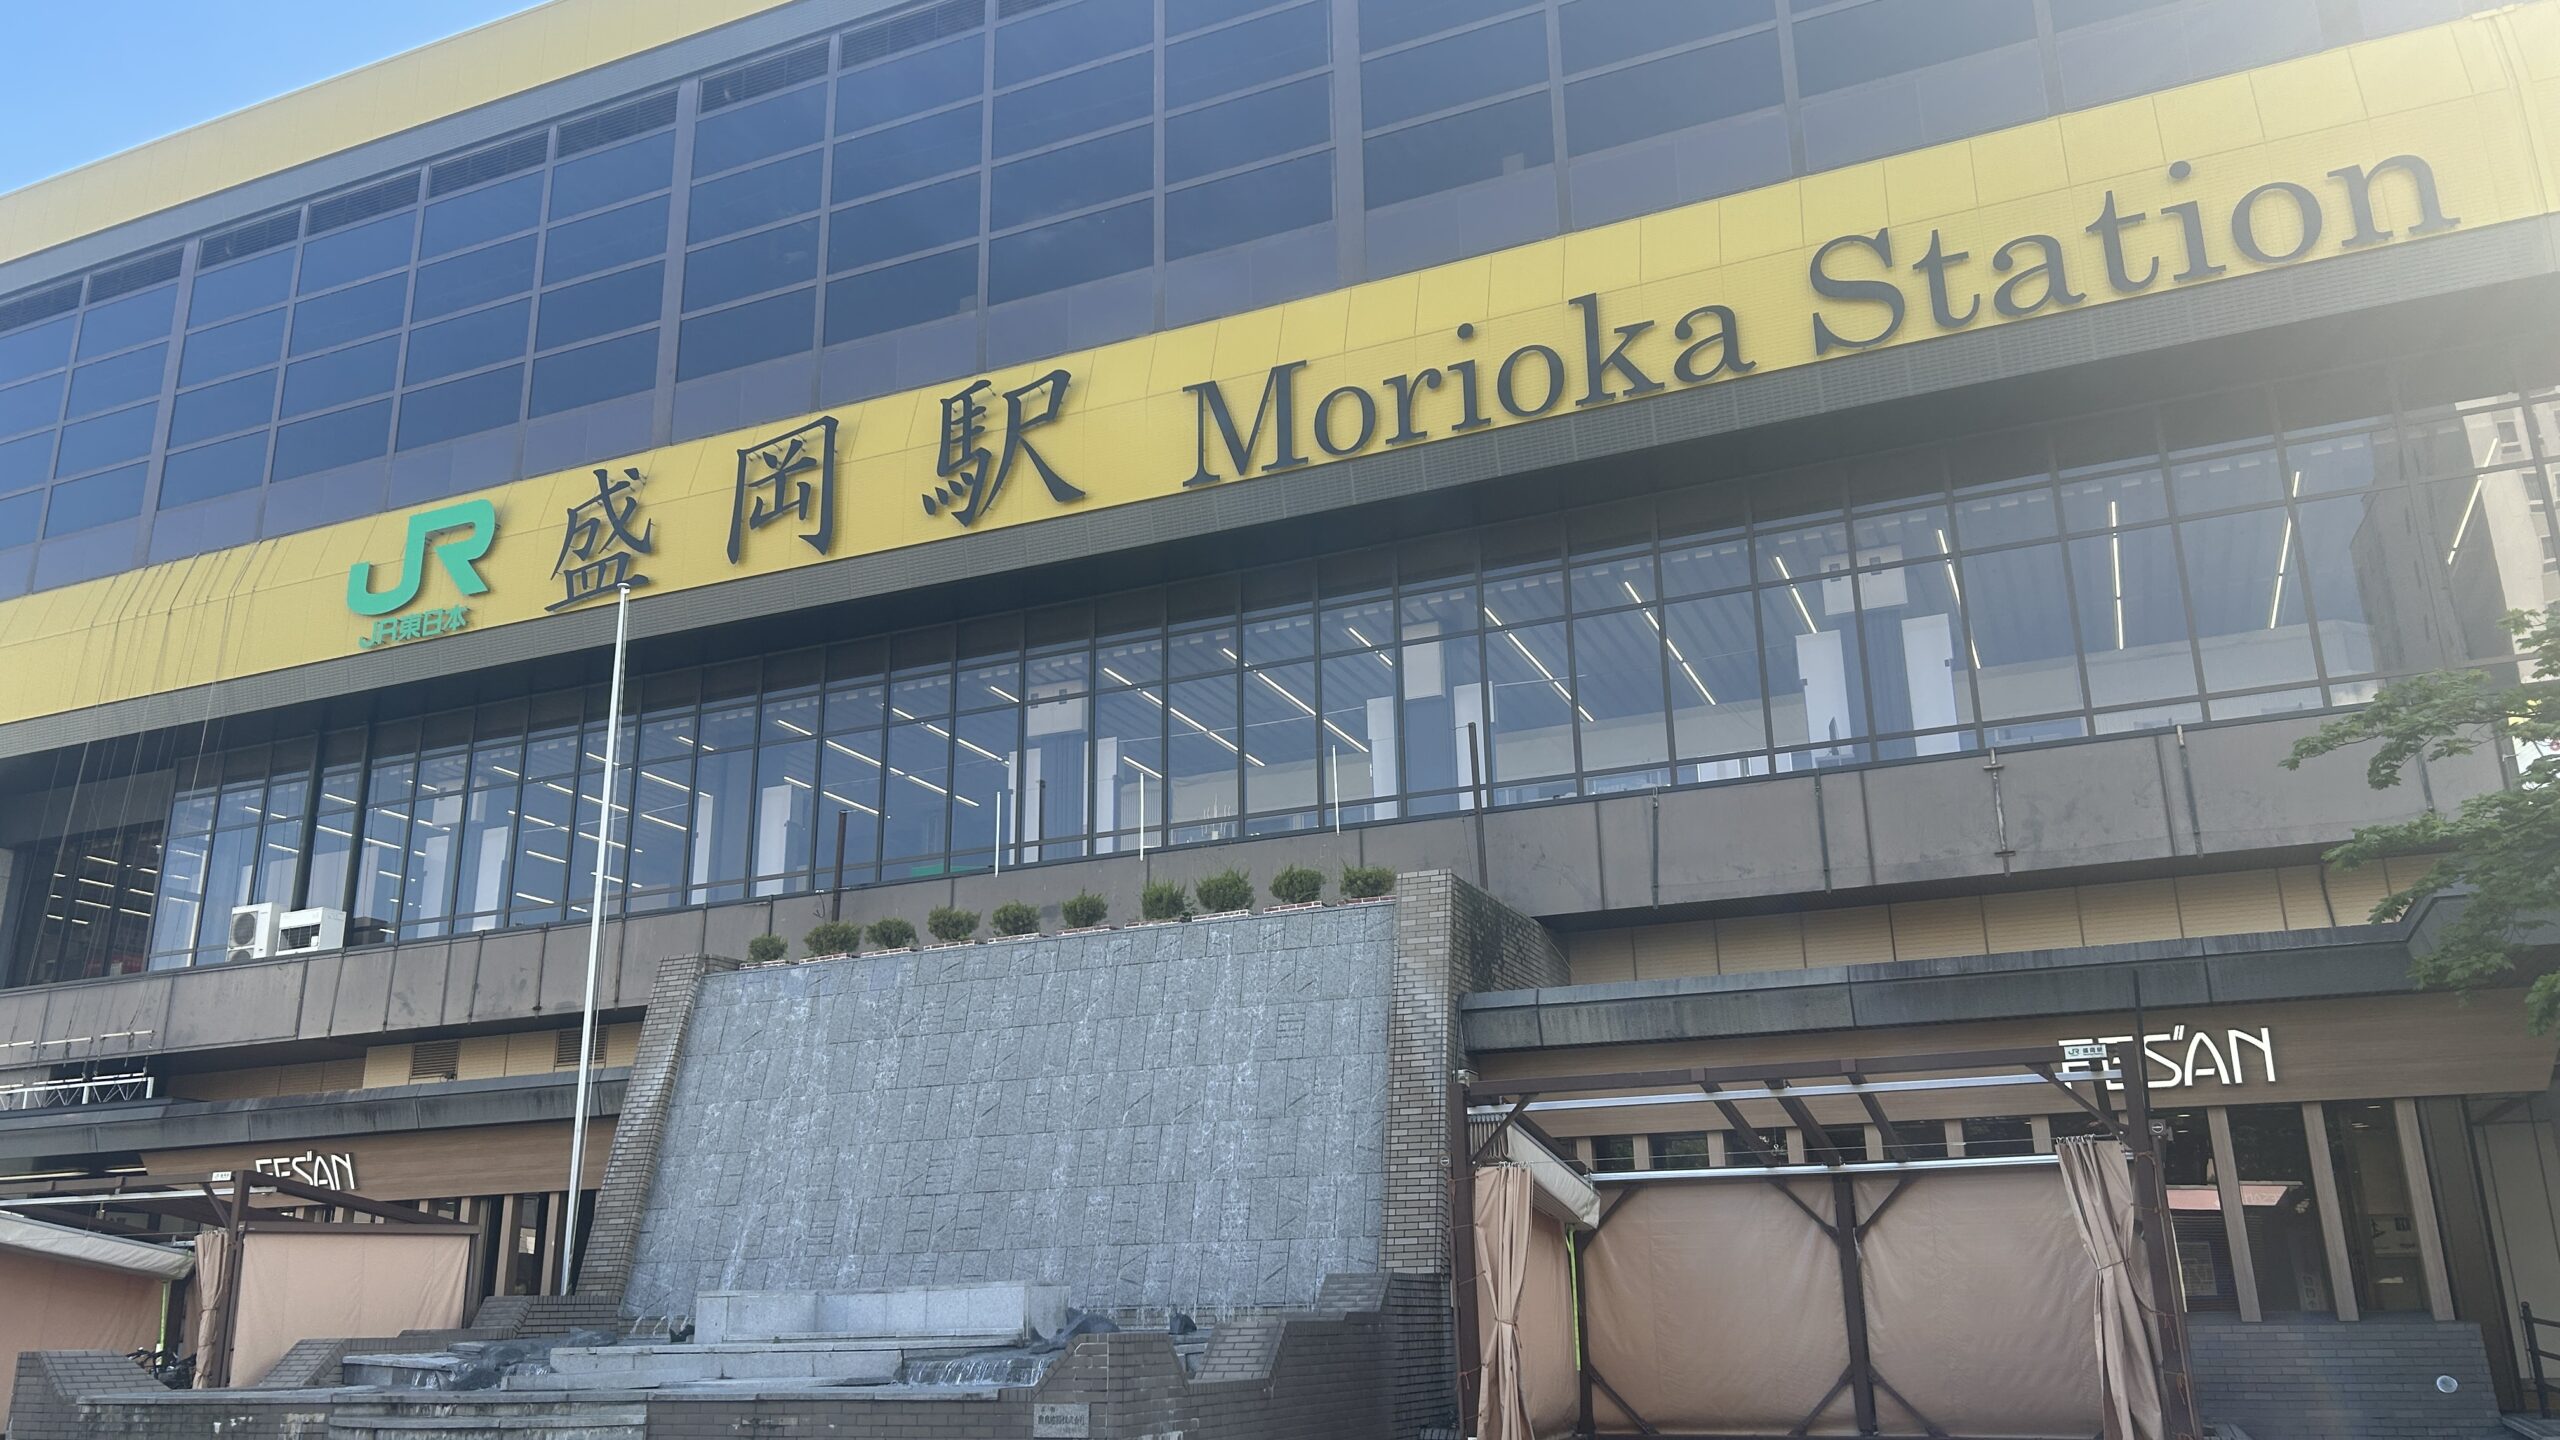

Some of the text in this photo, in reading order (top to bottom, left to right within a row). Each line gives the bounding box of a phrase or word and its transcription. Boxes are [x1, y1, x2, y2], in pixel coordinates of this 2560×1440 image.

[545, 153, 2461, 612] 盛岡駅 Morioka Station
[347, 498, 495, 616] JR
[358, 604, 469, 649] JR東日本
